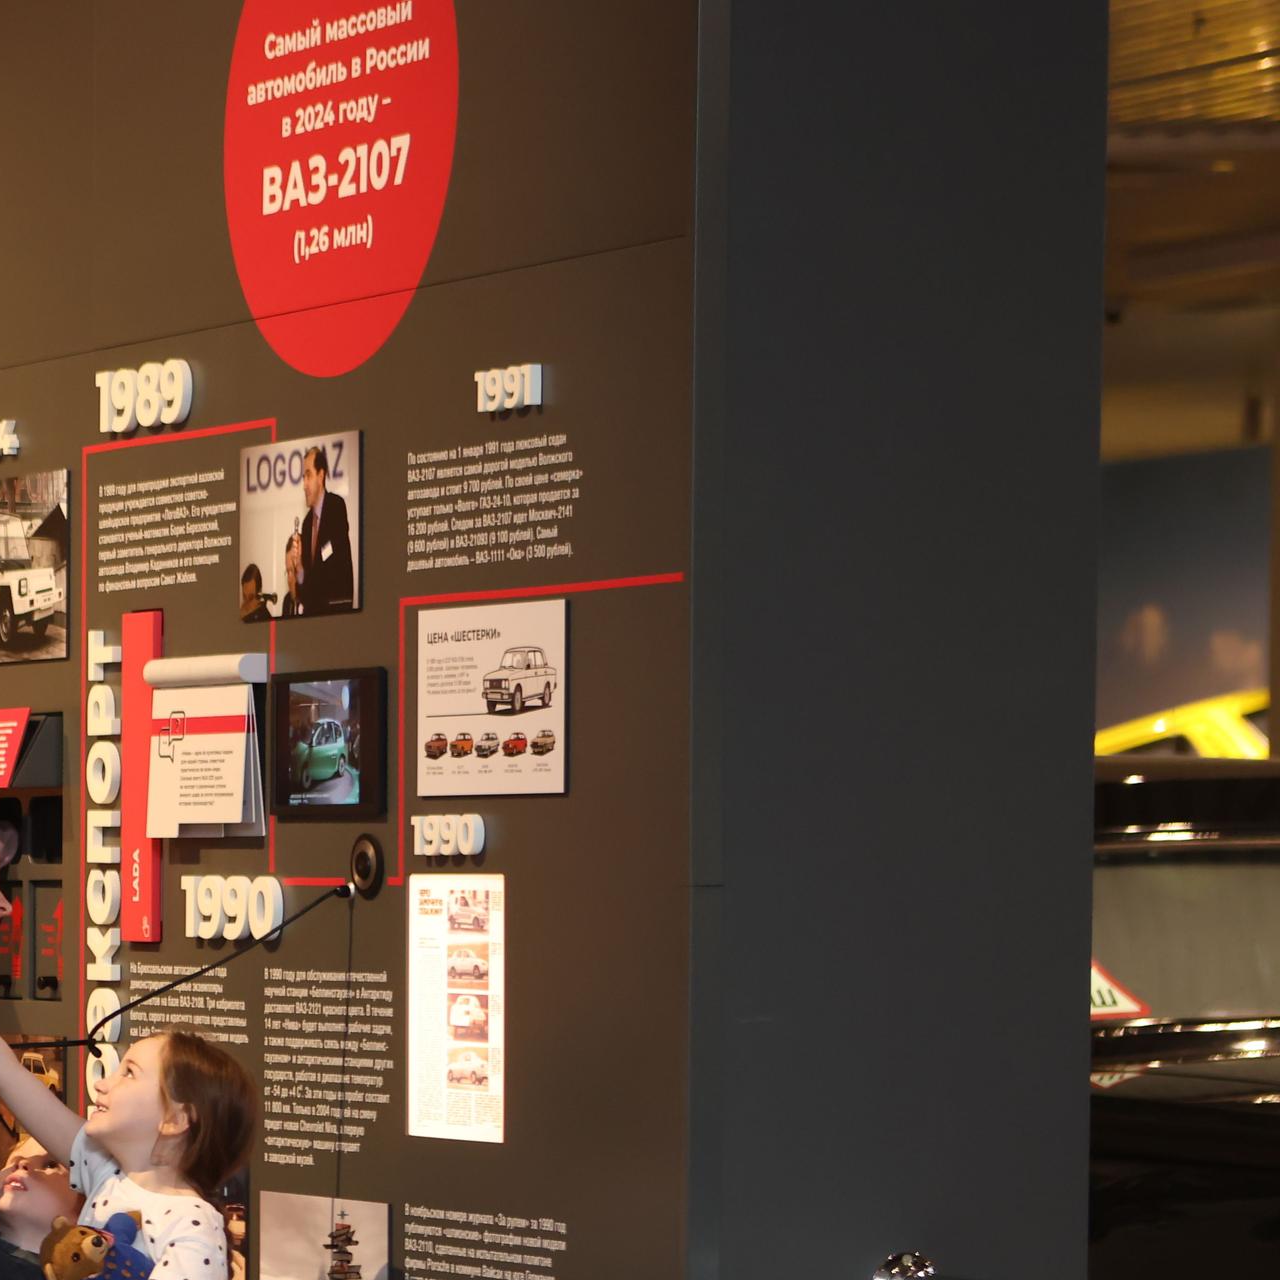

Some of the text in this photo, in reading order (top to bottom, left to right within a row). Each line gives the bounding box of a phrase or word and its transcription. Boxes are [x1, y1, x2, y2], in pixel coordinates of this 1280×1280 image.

[264, 0, 413, 60] Самый массовый
[246, 37, 430, 106] автомобиль в России
[281, 116, 291, 138] в
[294, 102, 336, 136] 2024
[339, 94, 379, 124] году
[261, 133, 411, 216] ВАЗ-2107
[293, 214, 374, 264] (1,26 млн)
[95, 358, 193, 433] 1989
[474, 363, 542, 412] 1991
[427, 627, 501, 645] ЦЕНА «ШЕСТЕРКИ»
[410, 813, 485, 857] 1990
[131, 848, 142, 902] LADA
[180, 874, 285, 940] 1990
